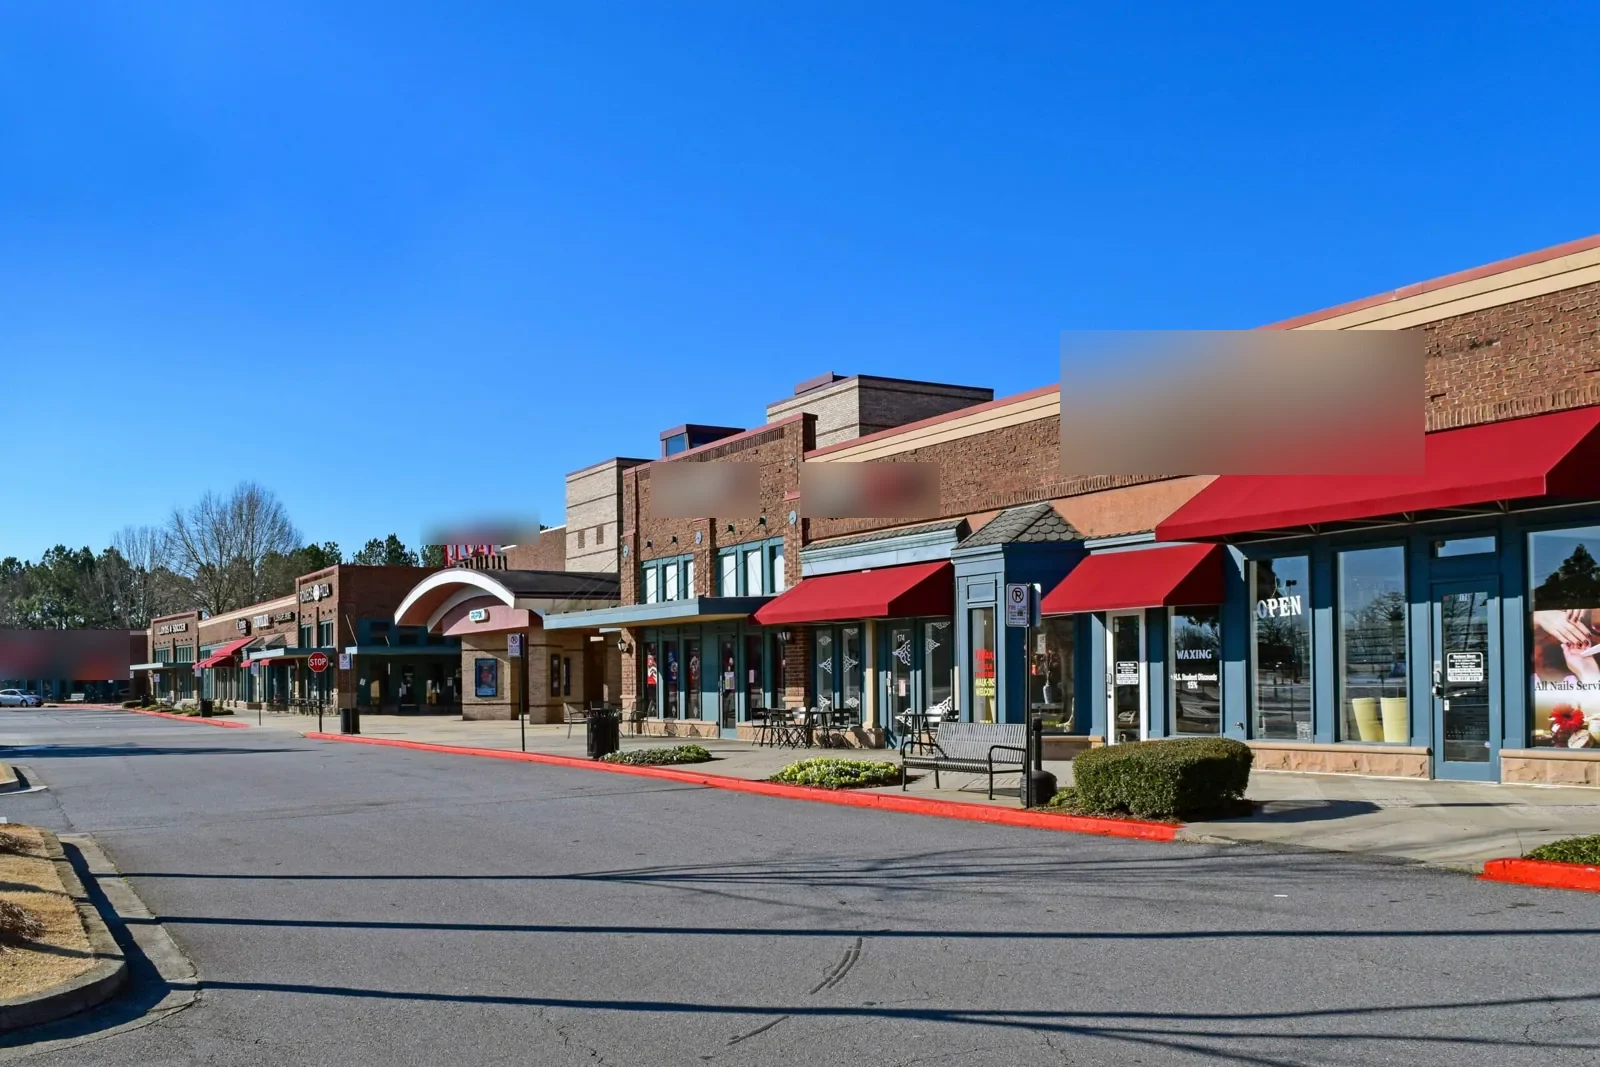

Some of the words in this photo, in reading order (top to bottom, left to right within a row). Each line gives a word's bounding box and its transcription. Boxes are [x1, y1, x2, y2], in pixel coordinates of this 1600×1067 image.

[1256, 595, 1302, 619] OPEN
[897, 634, 905, 642] 174
[1176, 649, 1212, 660] WAXING
[309, 658, 327, 667] STOP
[1535, 680, 1547, 691] All
[1550, 680, 1574, 691] Nails
[975, 688, 995, 697] WELCOM
